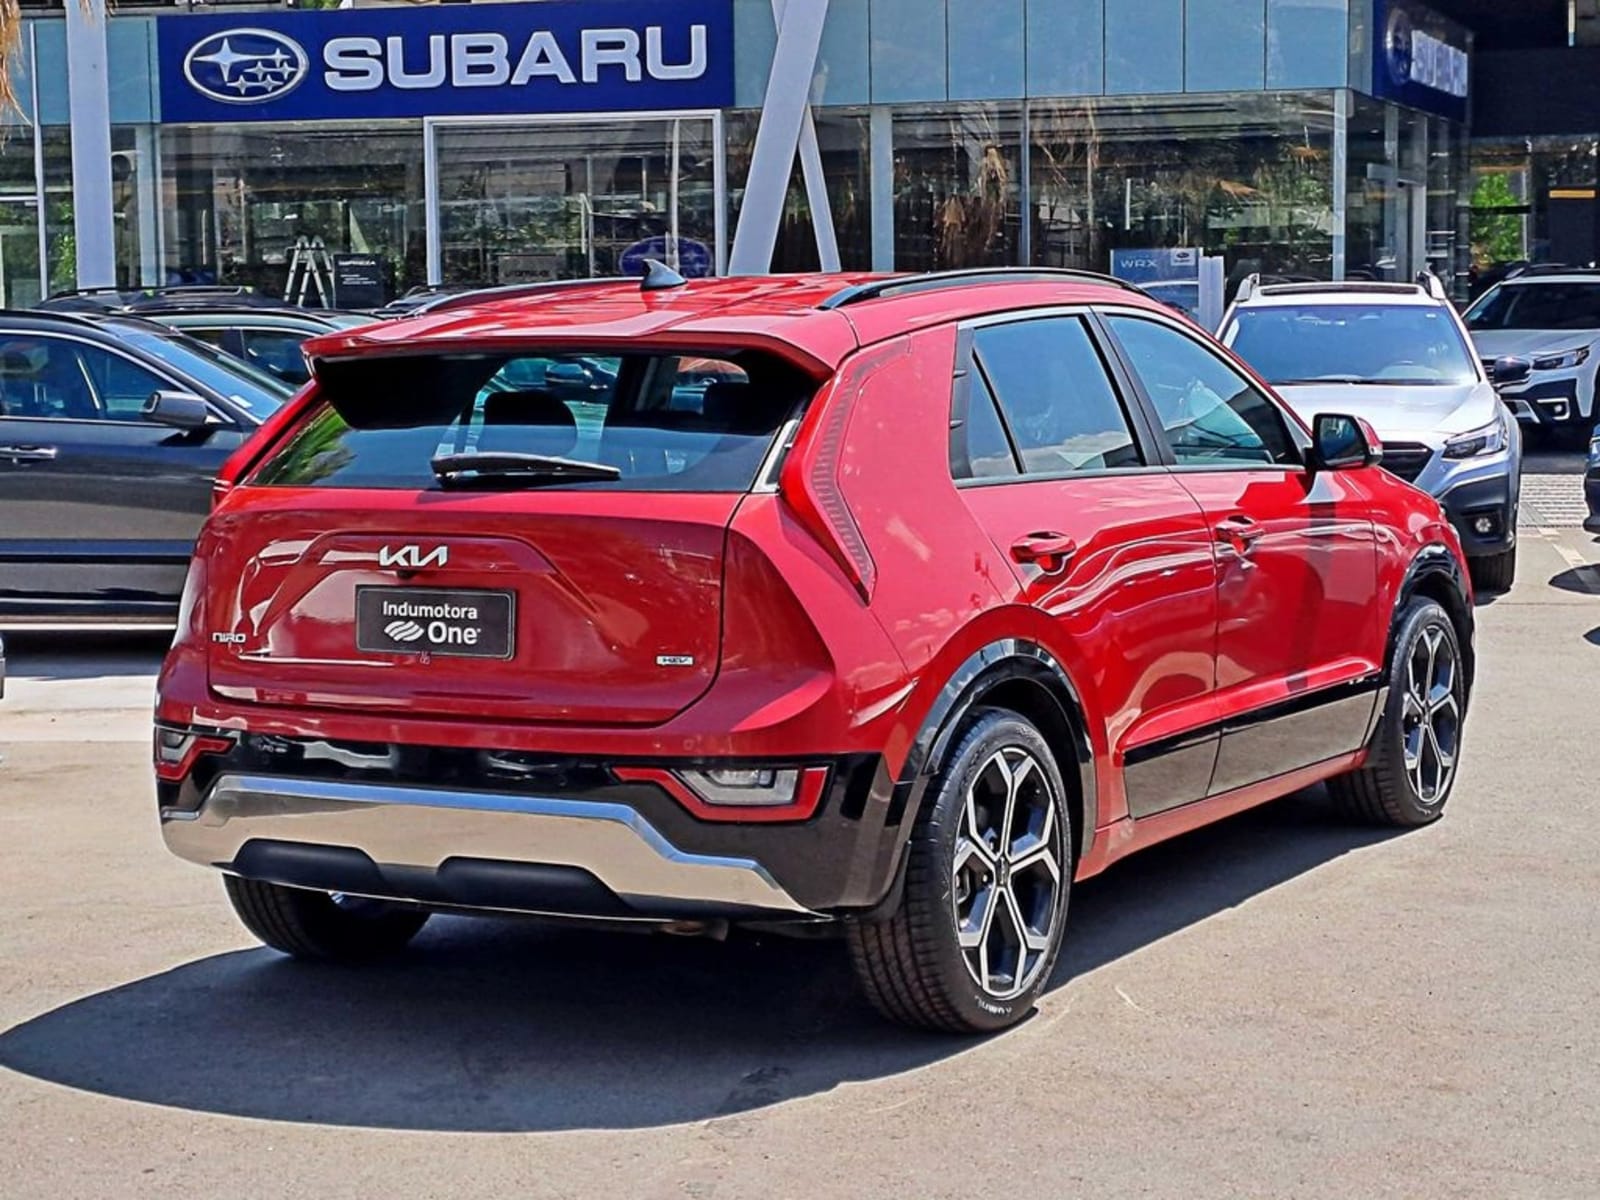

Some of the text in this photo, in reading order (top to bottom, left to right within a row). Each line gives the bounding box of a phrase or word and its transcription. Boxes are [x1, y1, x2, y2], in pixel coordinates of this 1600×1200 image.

[323, 24, 707, 91] SUBARU
[1120, 259, 1158, 268] WRX
[379, 545, 448, 567] KIA
[383, 601, 478, 619] Indumotora
[212, 632, 246, 643] NIRO
[427, 621, 478, 645] One
